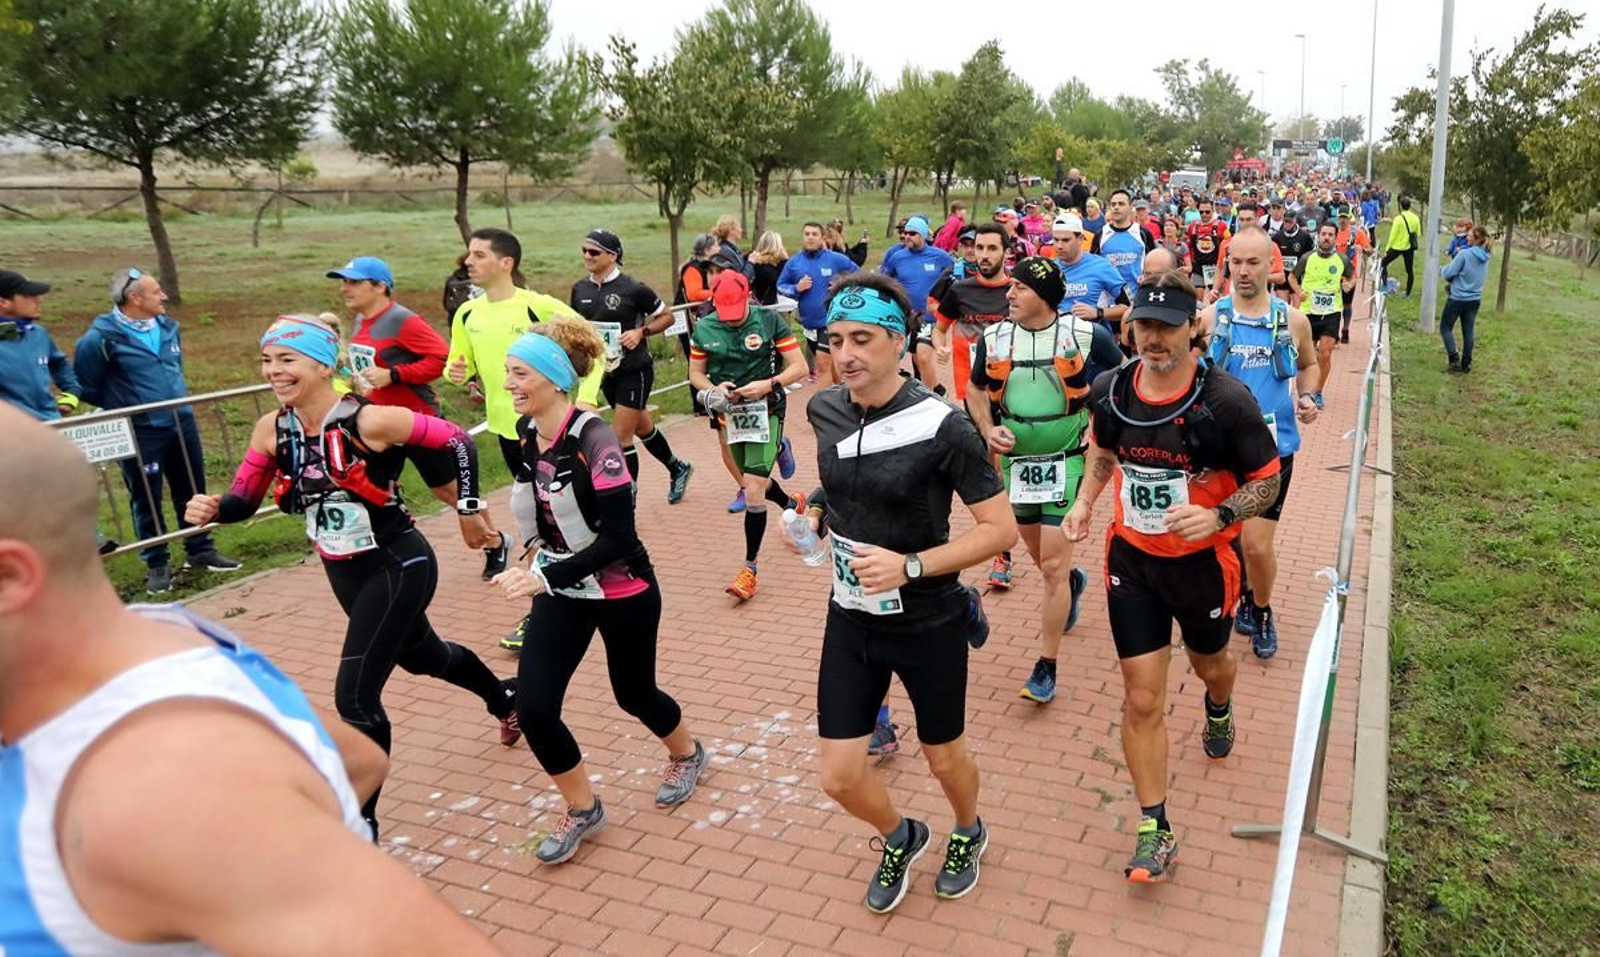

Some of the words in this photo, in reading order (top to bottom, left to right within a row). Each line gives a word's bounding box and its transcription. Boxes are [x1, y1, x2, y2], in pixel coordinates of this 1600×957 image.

[733, 414, 760, 429] 122
[1130, 447, 1192, 463] COREPLAY
[1020, 465, 1057, 485] 484
[1130, 483, 1172, 510] 185
